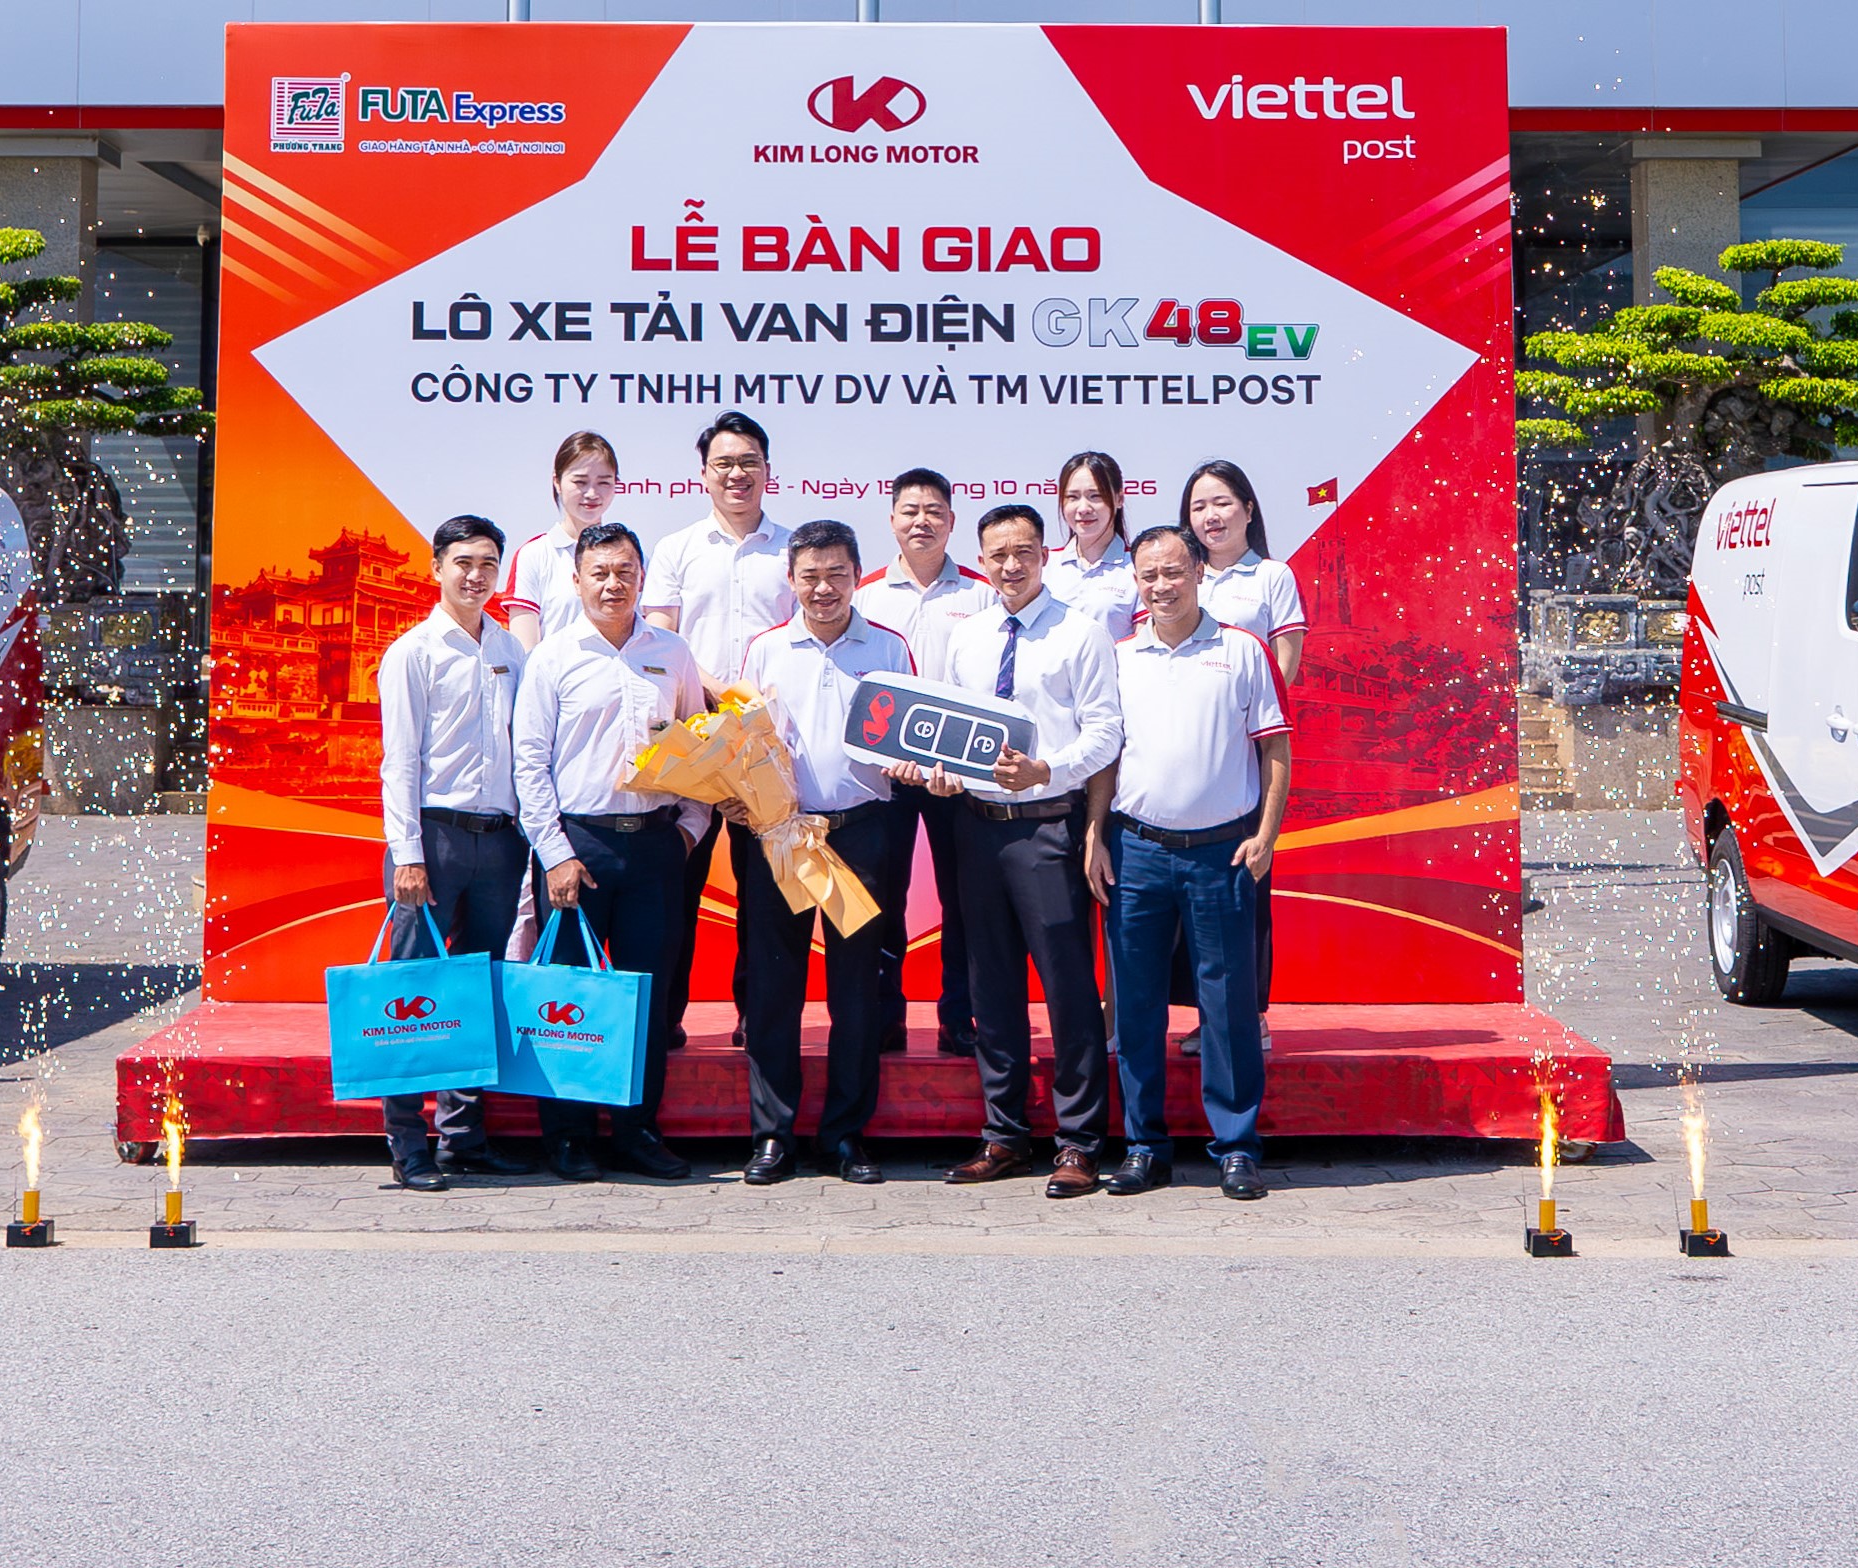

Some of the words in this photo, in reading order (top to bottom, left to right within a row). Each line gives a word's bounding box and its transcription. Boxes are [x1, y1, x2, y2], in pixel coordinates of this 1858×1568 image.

[360, 89, 446, 120] FUTA
[455, 93, 564, 126] Express
[1186, 74, 1416, 120] viettel
[312, 143, 343, 151] TRANG
[360, 142, 387, 151] GIAO
[389, 140, 421, 151] HÀNG
[447, 140, 470, 151] NHÀ
[479, 140, 495, 152] CÓ
[754, 145, 804, 163] KIM
[811, 145, 879, 163] LONG
[886, 145, 980, 164] MOTOR
[1343, 134, 1417, 164] post
[631, 198, 720, 272] LỄ
[742, 215, 900, 272] BÀN
[922, 227, 1101, 272] GIAO
[412, 292, 492, 341] LÔ
[508, 302, 592, 342] XE
[610, 291, 704, 342] TẢI
[719, 303, 849, 342] VAN
[864, 294, 1015, 351] ĐIỆN
[411, 364, 534, 404] CÔNG
[544, 373, 599, 403] TY
[610, 374, 722, 404] TNHH
[734, 374, 824, 404] MTV
[835, 374, 891, 404] DV
[901, 365, 957, 404] VÀ
[968, 375, 1028, 404] TM
[1039, 374, 1322, 405] VIETTELPOST
[670, 478, 710, 498] ph
[802, 476, 870, 499] Ngày
[993, 480, 1018, 495] 10
[1026, 478, 1058, 495] nă
[1716, 497, 1777, 551] viettel
[1743, 568, 1765, 601] post
[362, 1026, 385, 1037] KIM
[387, 1024, 418, 1035] LONG
[420, 1019, 462, 1032] MOTOR
[516, 1026, 537, 1036] KIM
[538, 1028, 565, 1039] LONG
[567, 1031, 604, 1043] MOTOR
